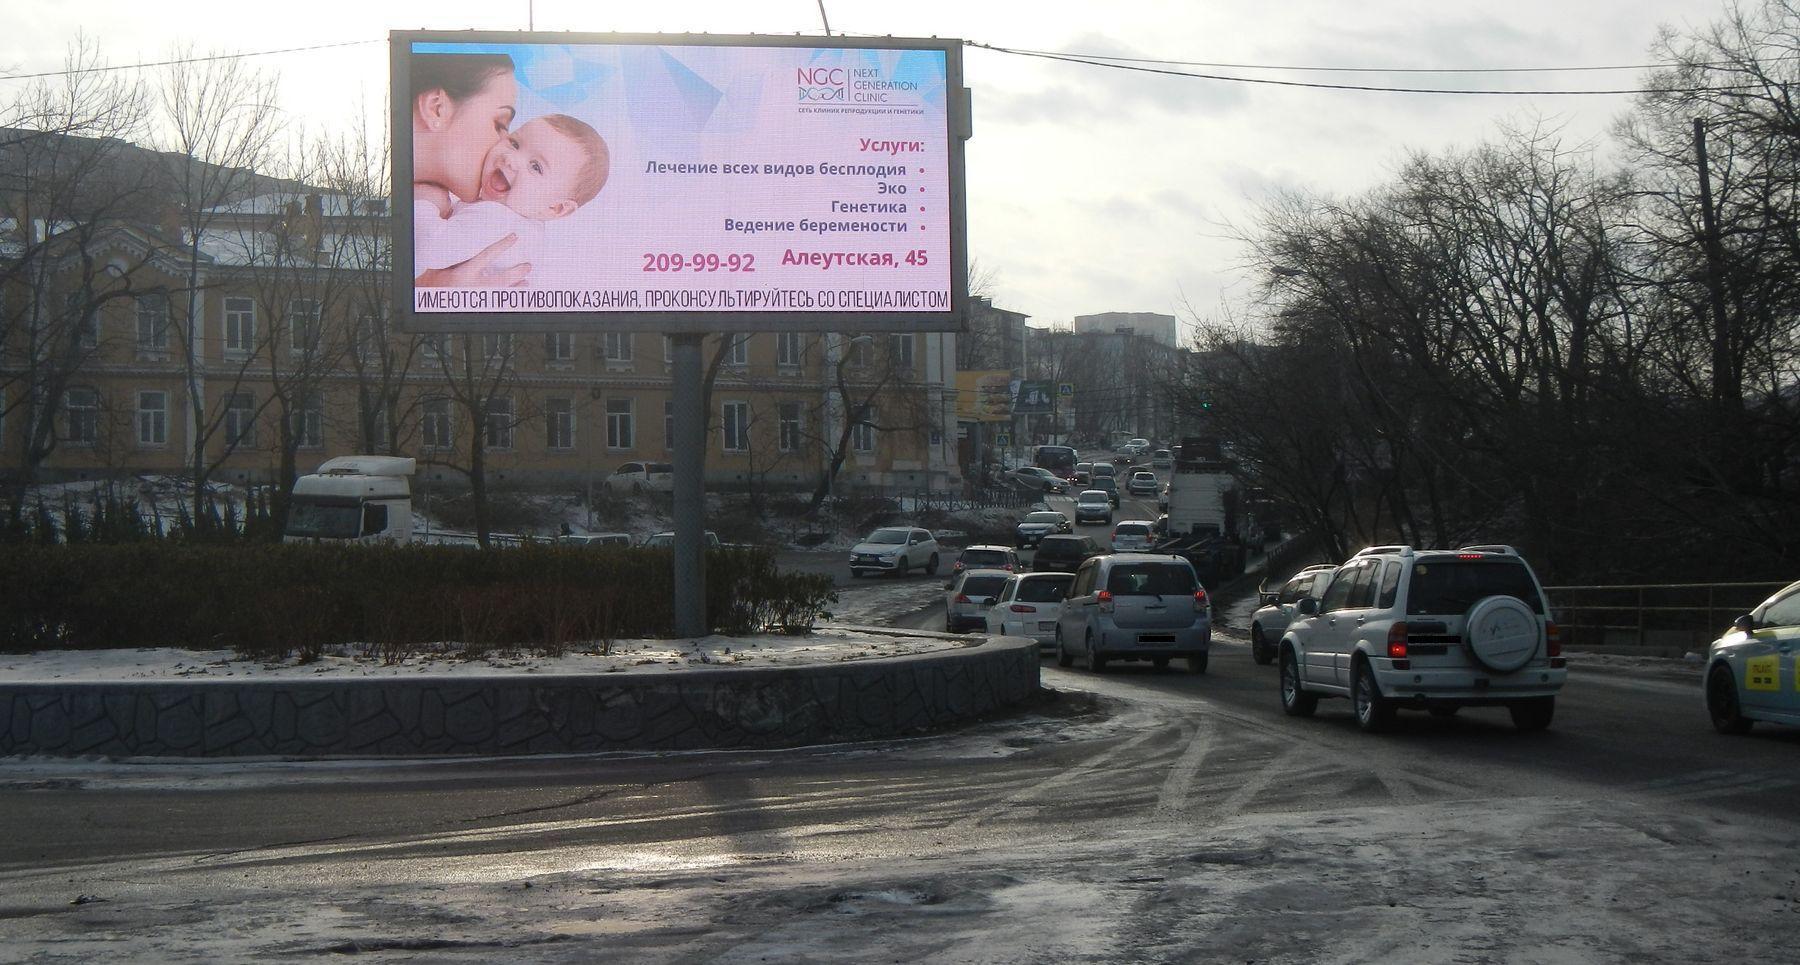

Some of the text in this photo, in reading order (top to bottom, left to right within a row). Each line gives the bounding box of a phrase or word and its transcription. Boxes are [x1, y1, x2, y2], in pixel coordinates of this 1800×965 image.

[798, 67, 844, 86] NGC
[853, 69, 879, 78] NEXT
[854, 81, 918, 91] GENERATION
[854, 93, 888, 103] CLINIC
[859, 138, 925, 156] Услуги:
[645, 161, 907, 178] Лечение всех видов бесплодия
[877, 182, 907, 194] Эко
[831, 201, 907, 214] Генетика
[724, 218, 907, 234] Ведение беремености
[642, 253, 755, 273] 209-99-92
[781, 249, 929, 270] Алеутская, 45
[418, 288, 948, 309] ИМЕЮТСЯ ПРОТИВОПОКАЗАНИЯ, ПРОКОНСУЛЬТИРУЙТЕСЬ СО СПЕЦИАЛИСТОМ
